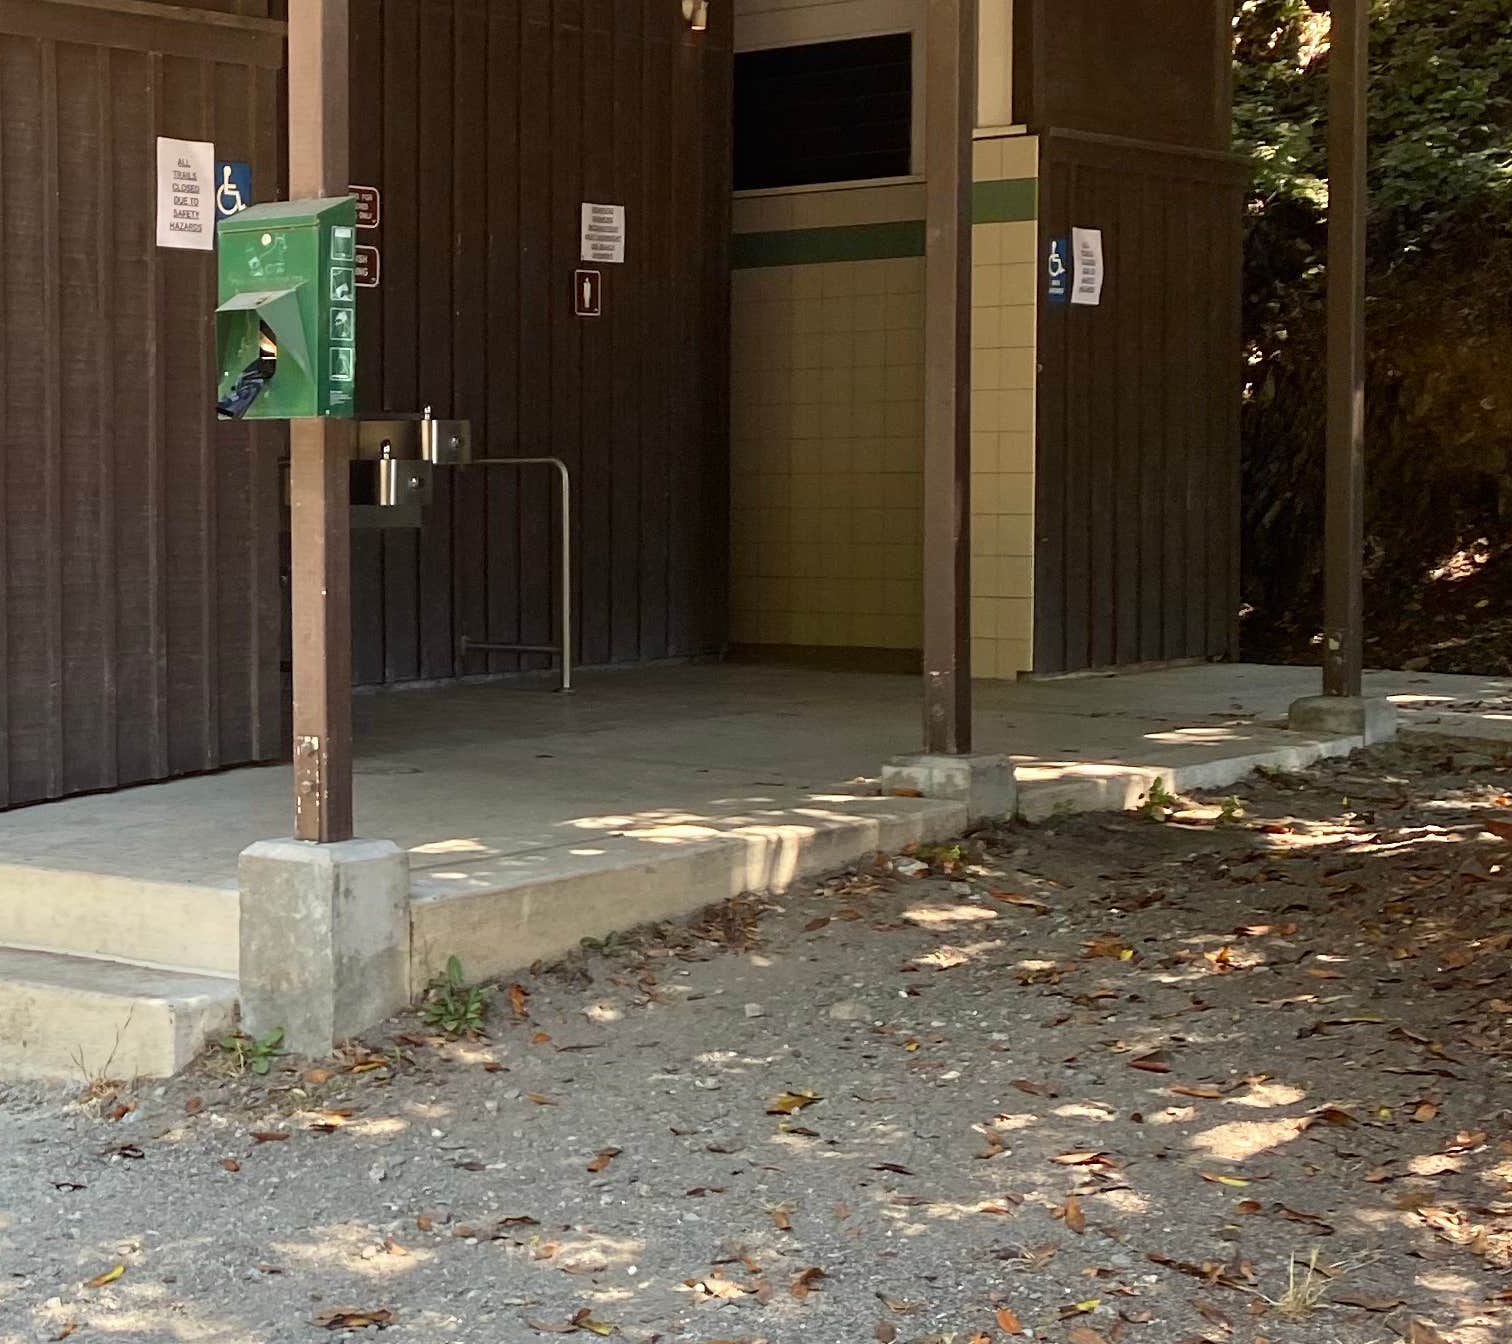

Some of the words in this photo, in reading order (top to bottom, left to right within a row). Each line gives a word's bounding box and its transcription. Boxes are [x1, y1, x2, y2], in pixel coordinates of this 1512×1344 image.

[177, 158, 191, 168] ALL
[173, 170, 197, 181] TRAILS
[172, 183, 200, 194] CLOSED
[173, 196, 188, 206] DUE
[190, 197, 199, 207] TO
[173, 209, 199, 220] SAFETY
[169, 222, 202, 232] HAZARDS
